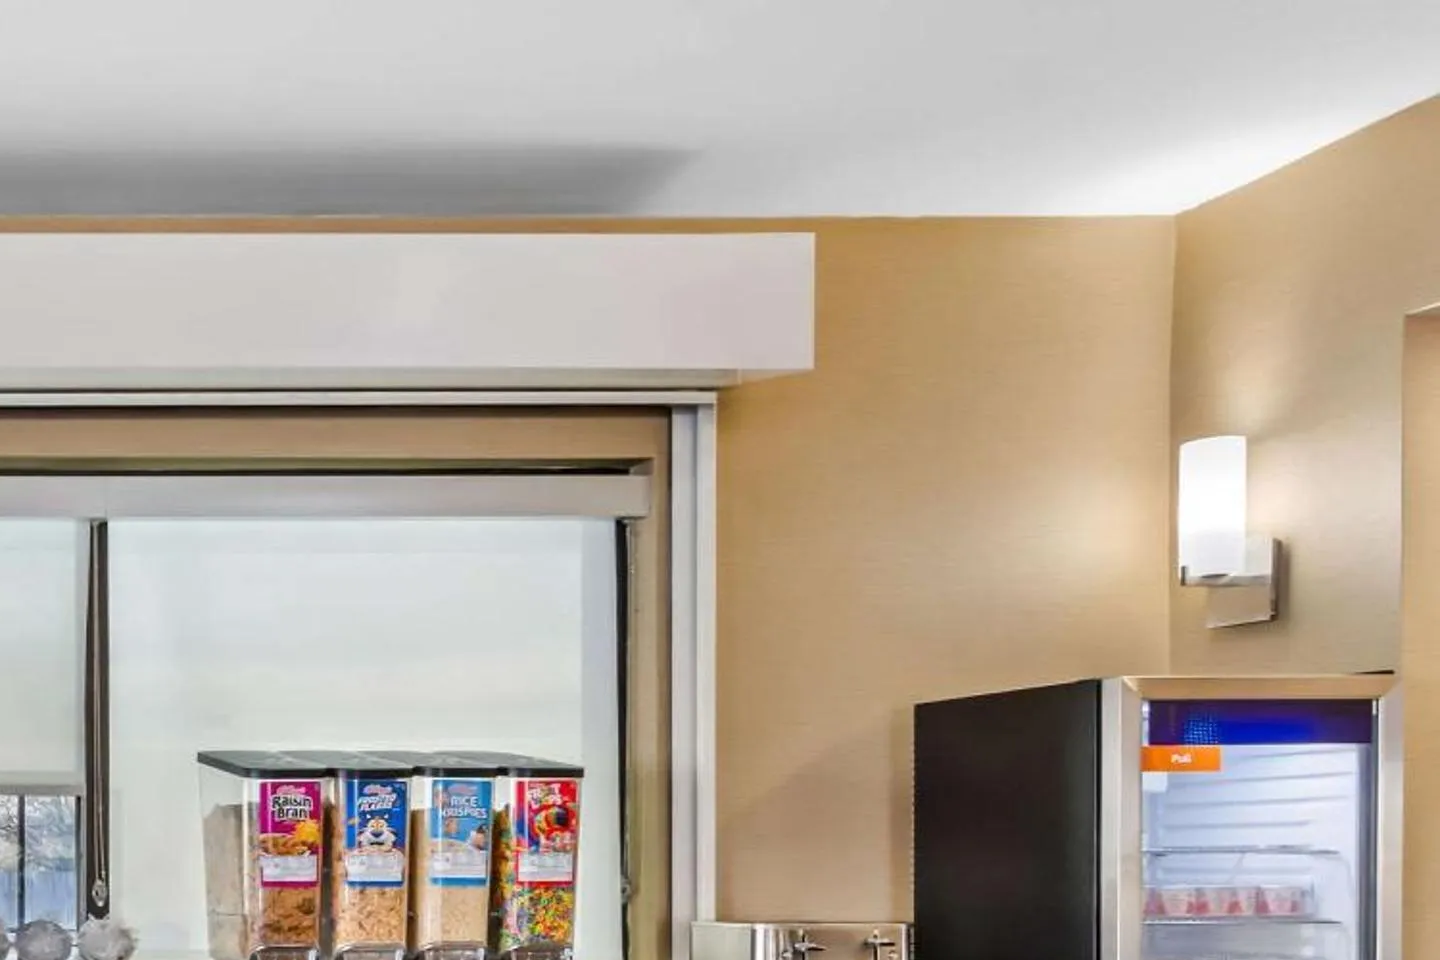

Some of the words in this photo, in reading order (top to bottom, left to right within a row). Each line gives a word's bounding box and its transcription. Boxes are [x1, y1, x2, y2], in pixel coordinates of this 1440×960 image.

[271, 795, 312, 808] Raisin
[450, 796, 478, 807] RICE
[276, 807, 307, 820] Bran
